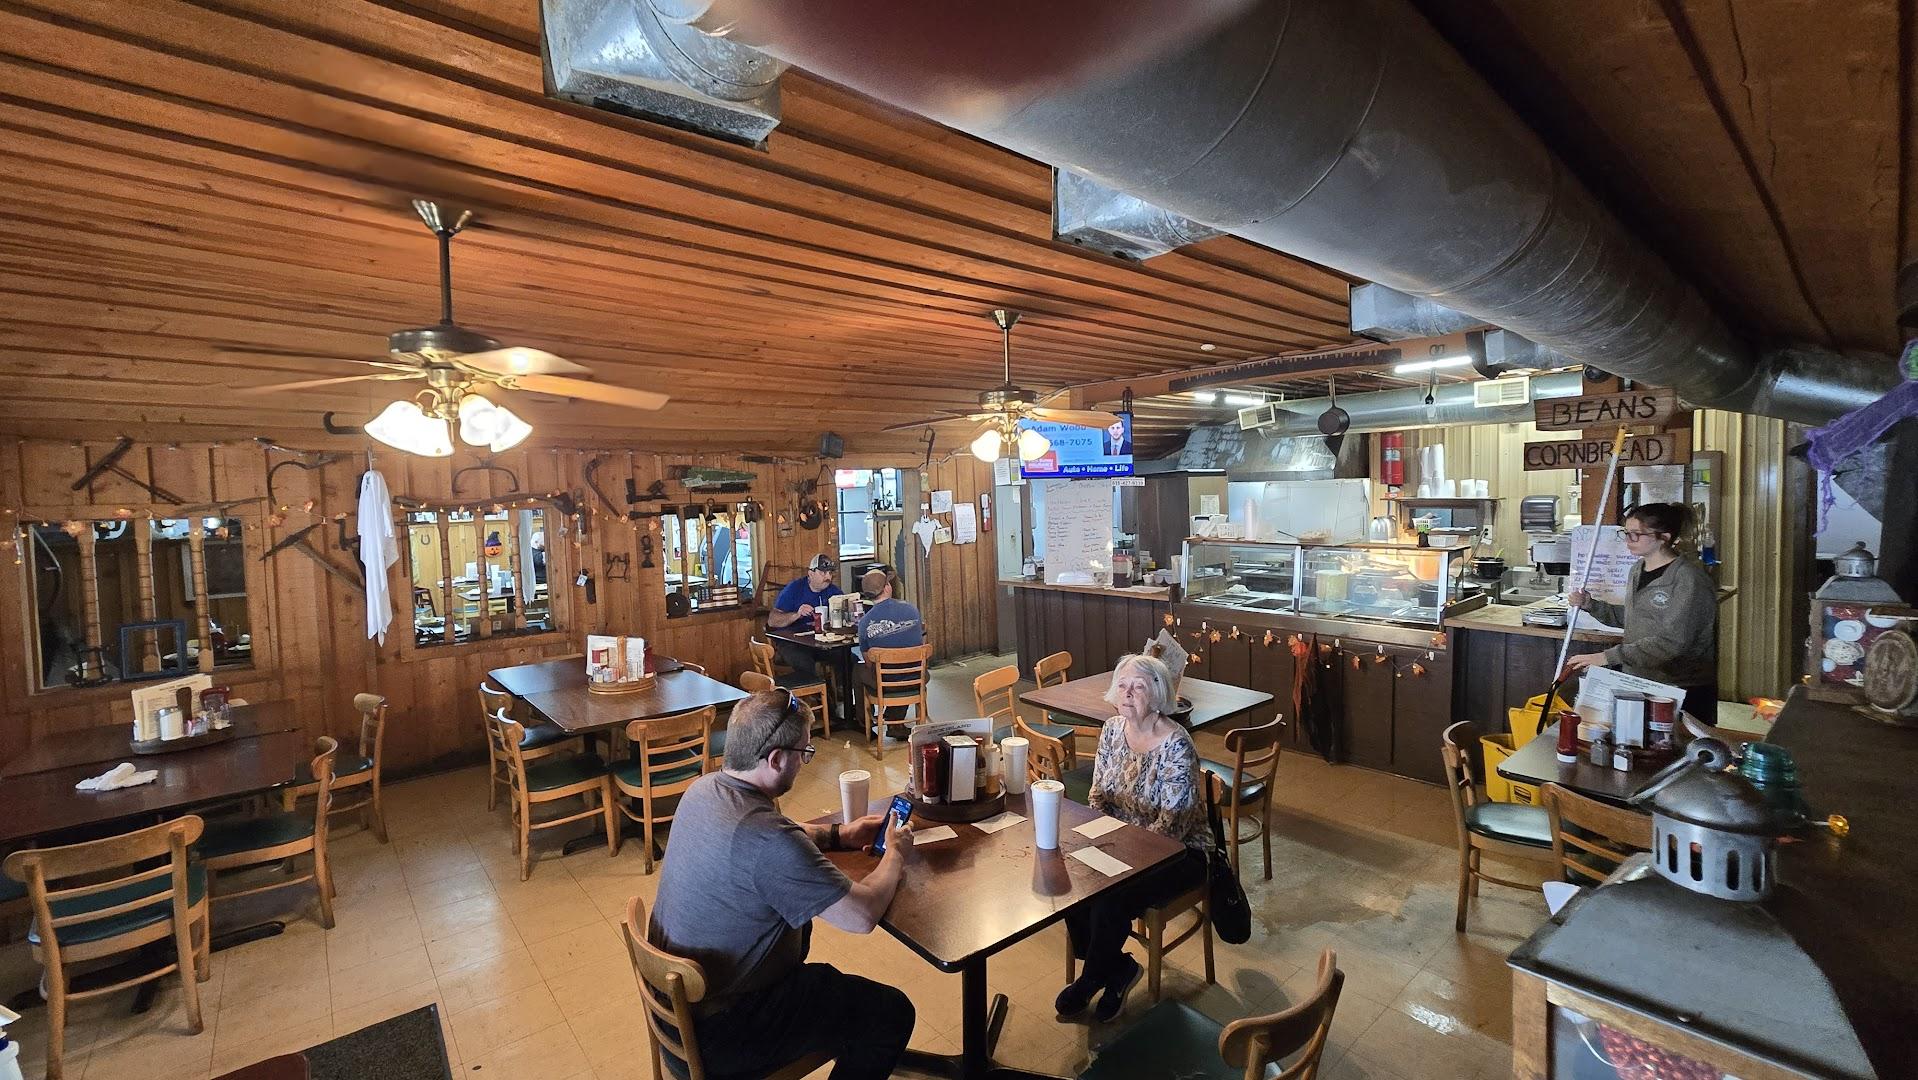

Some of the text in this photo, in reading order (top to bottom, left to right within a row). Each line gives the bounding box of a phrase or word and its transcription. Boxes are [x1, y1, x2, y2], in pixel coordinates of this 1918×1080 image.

[1552, 396, 1657, 426] BEANS
[1526, 438, 1664, 467] CORNBREAD
[1063, 464, 1130, 473] Auto Home Life
